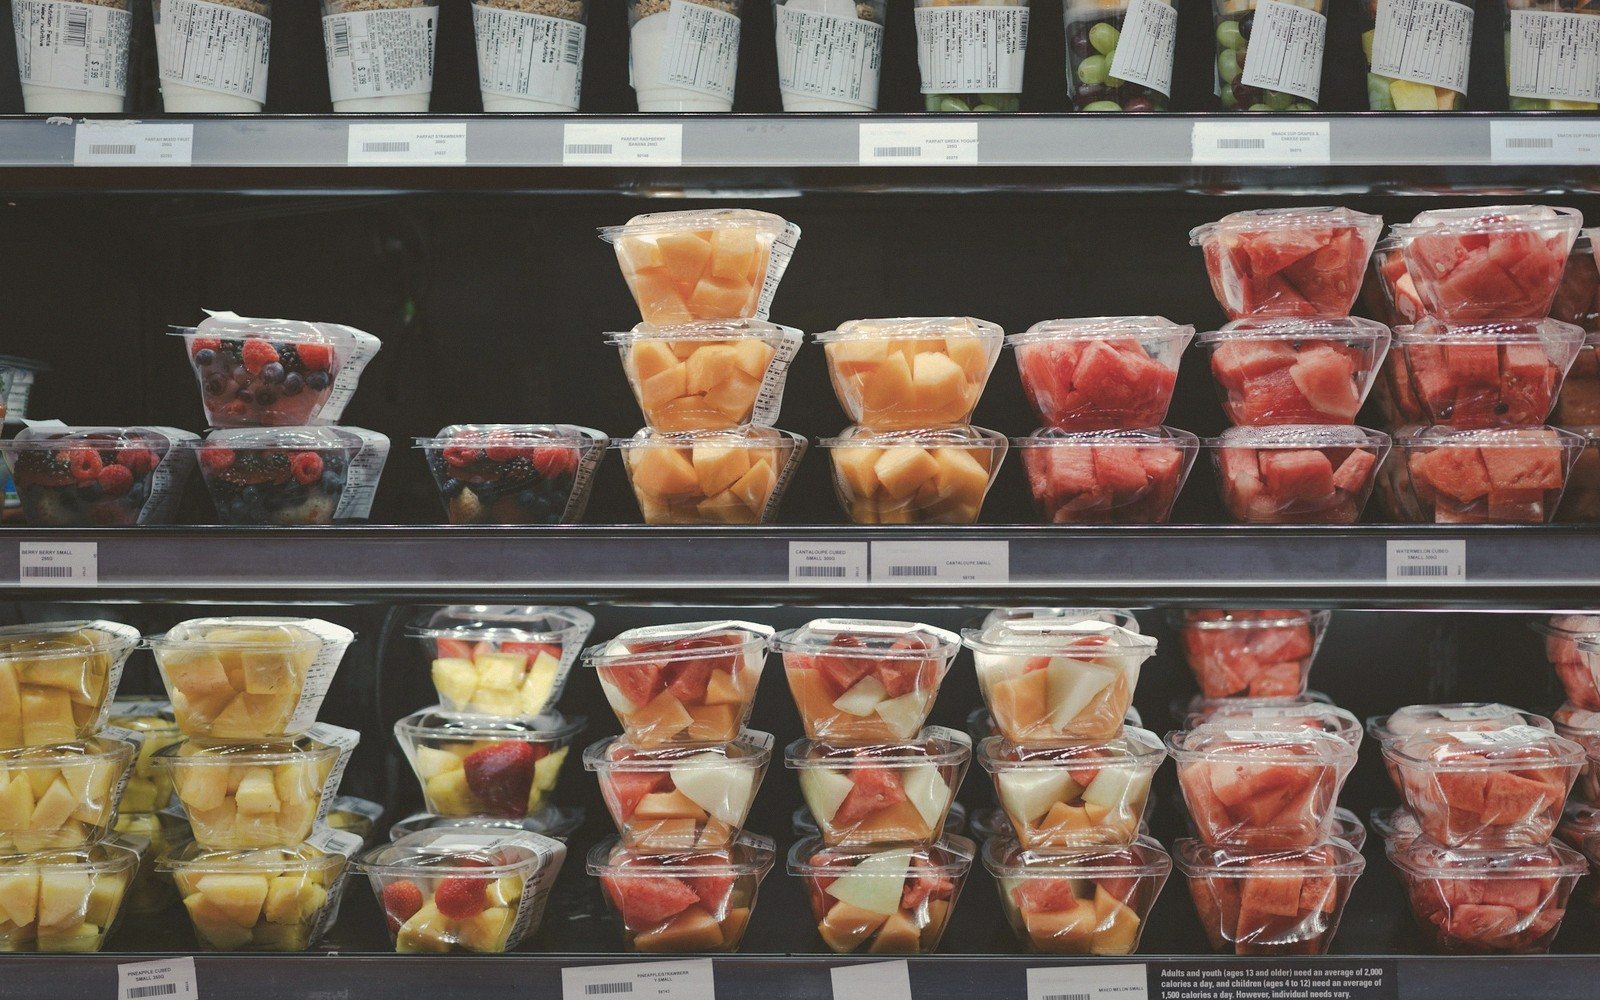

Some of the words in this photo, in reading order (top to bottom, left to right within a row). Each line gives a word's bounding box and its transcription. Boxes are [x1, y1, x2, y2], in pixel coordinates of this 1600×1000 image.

[426, 30, 435, 76] Loblaws
[1161, 969, 1184, 977] Adults
[1202, 969, 1222, 978] youth
[1224, 969, 1244, 978] (ages
[1270, 968, 1292, 977] older)
[1364, 968, 1383, 977] 2,000
[1200, 980, 1214, 989] day,
[1263, 979, 1283, 989] (ages
[1300, 979, 1311, 988] 12)
[1343, 980, 1372, 988] average
[1161, 991, 1180, 999] 1,500
[1219, 991, 1234, 1000] day.
[1236, 991, 1270, 999] However,
